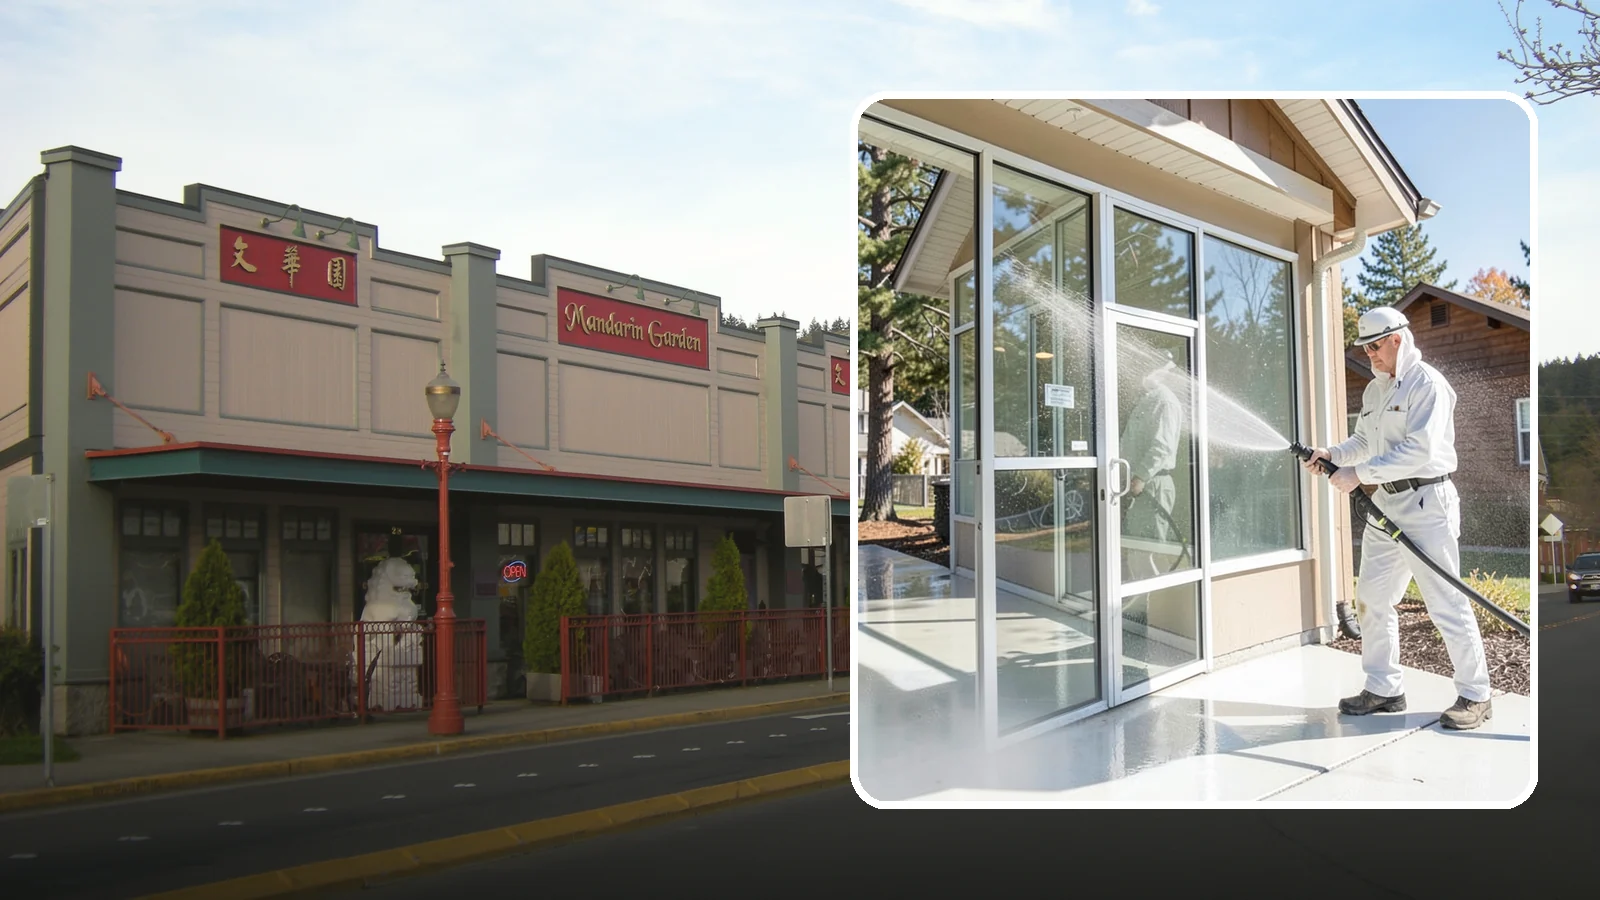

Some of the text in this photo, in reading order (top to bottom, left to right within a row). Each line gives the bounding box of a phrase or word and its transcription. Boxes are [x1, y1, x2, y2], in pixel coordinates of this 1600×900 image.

[231, 235, 346, 291] 文華園
[564, 302, 701, 352] Mandarin Garden
[503, 565, 527, 578] OPEN
